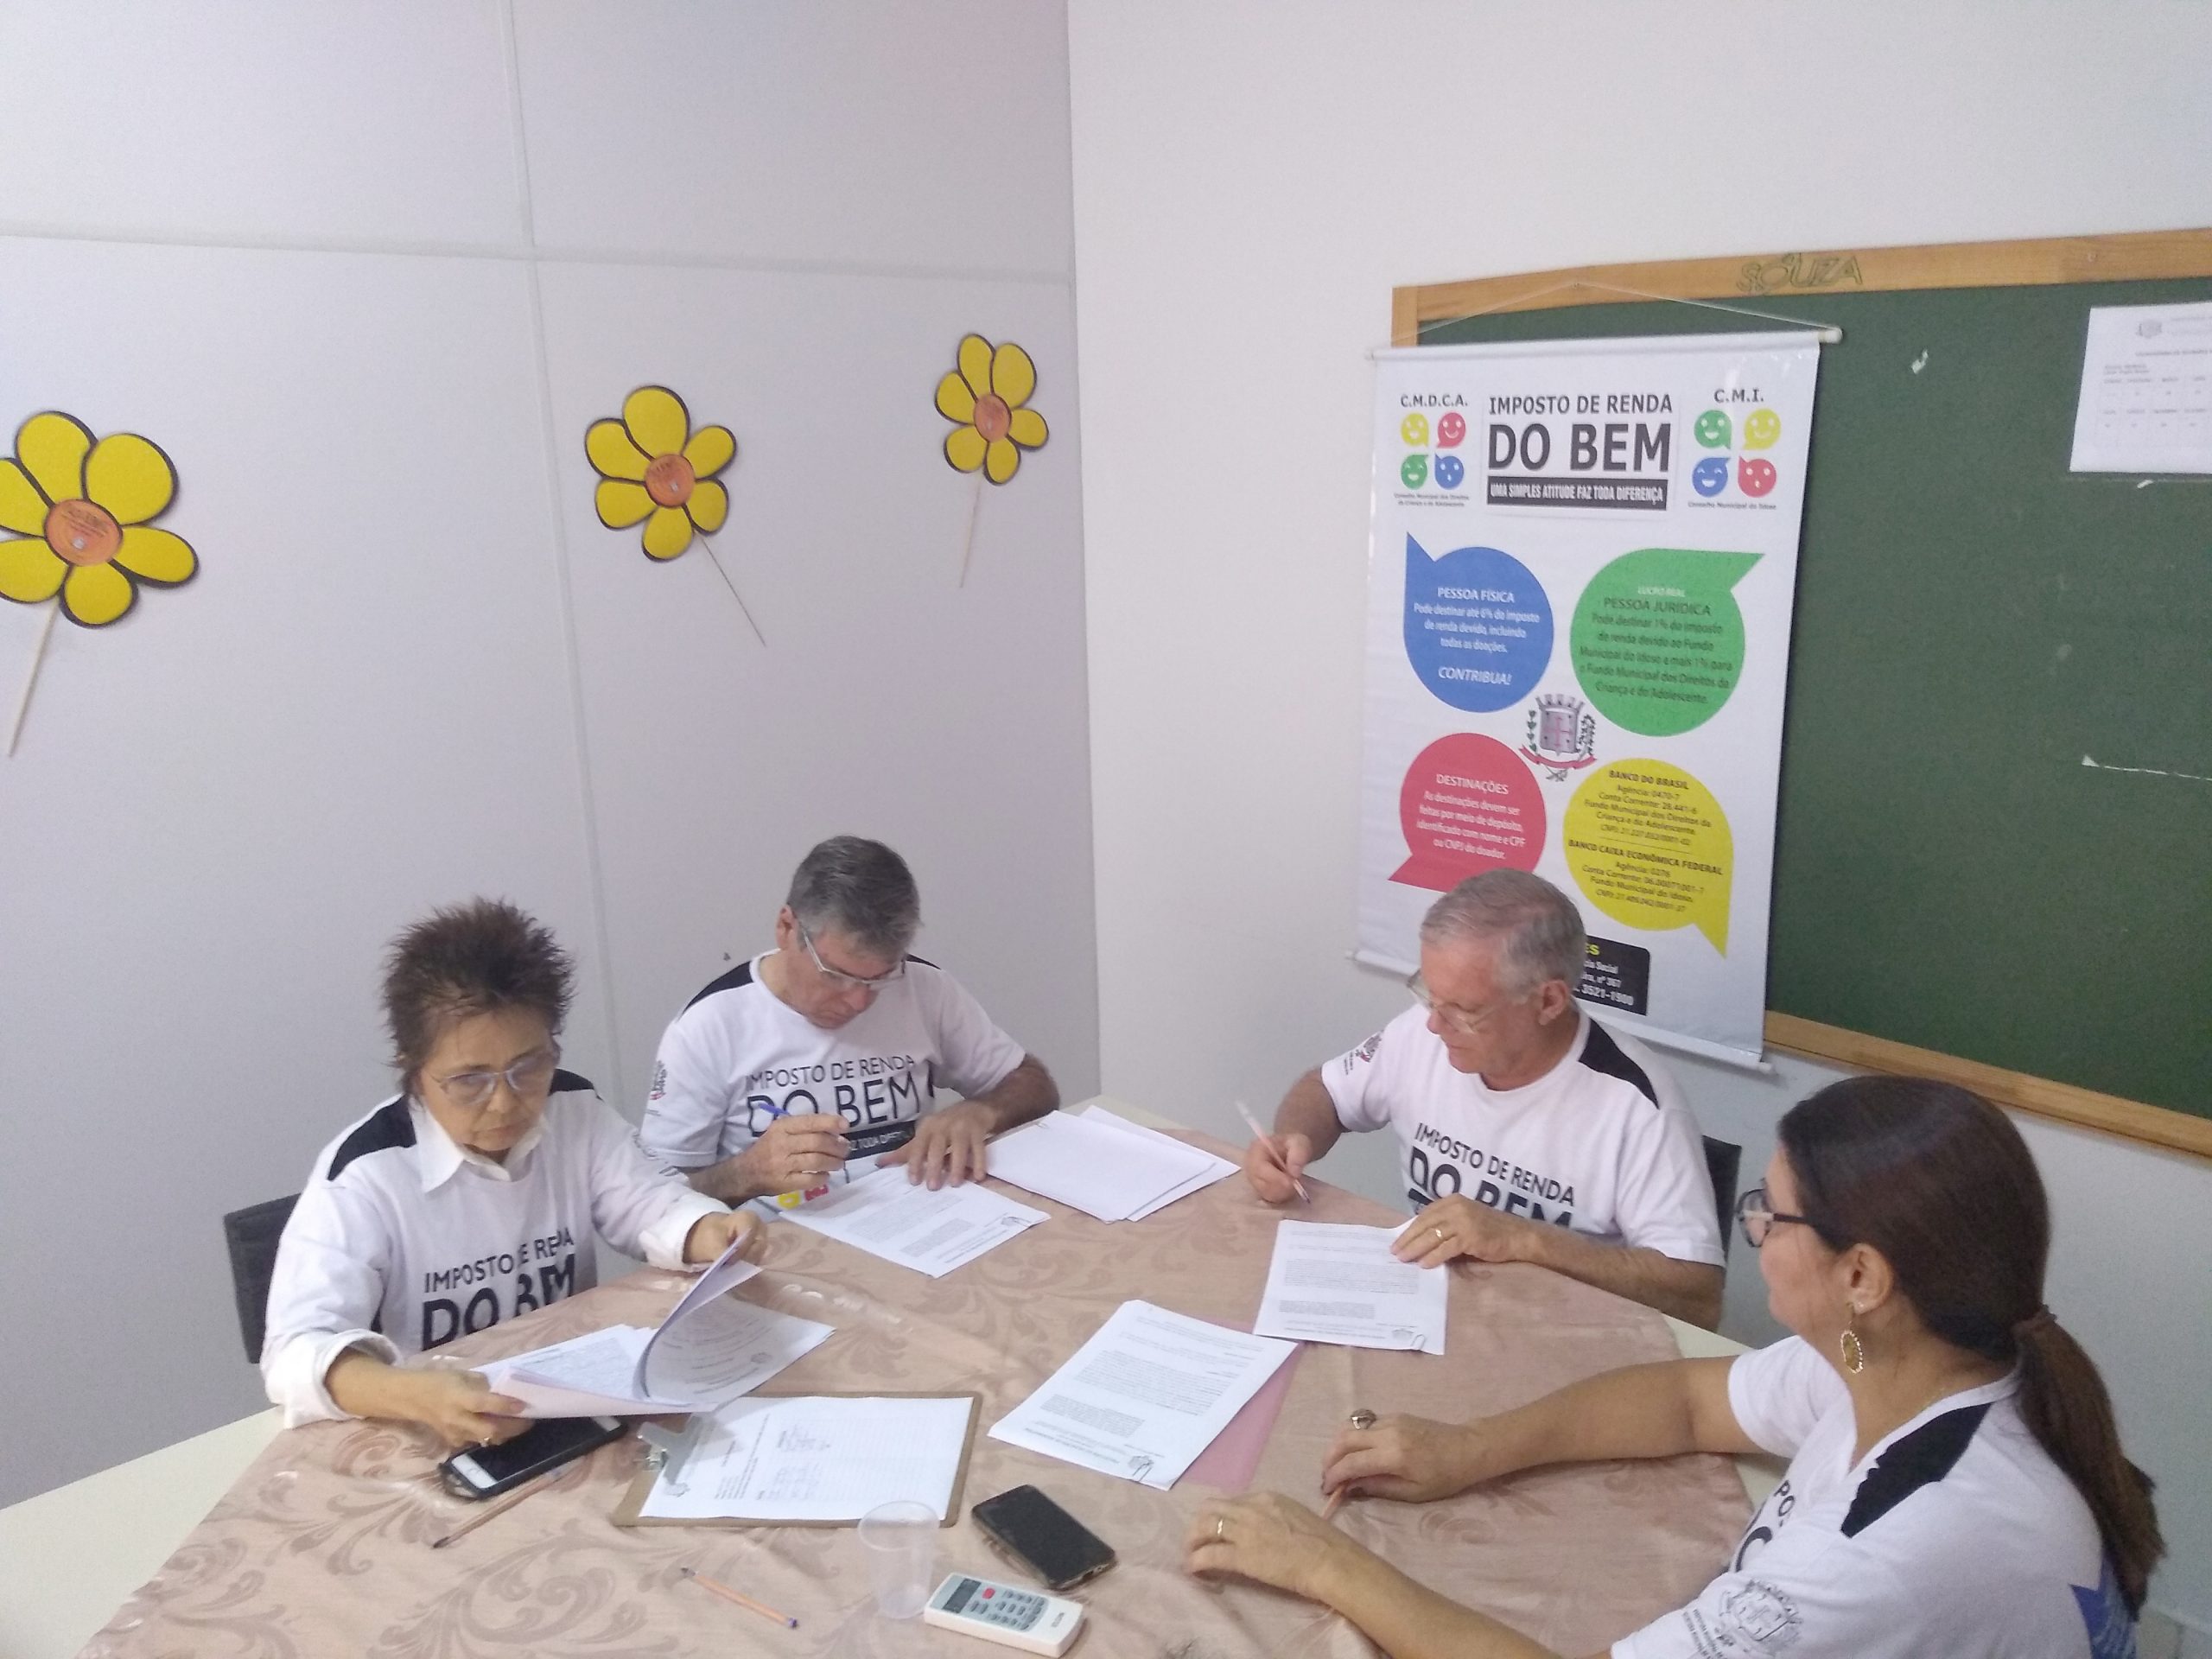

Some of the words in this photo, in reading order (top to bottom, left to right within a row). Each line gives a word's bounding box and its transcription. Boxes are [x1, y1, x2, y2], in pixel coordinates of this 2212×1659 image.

[1736, 252, 1863, 292] SOUZA
[1401, 393, 1468, 408] C.M.D.C.A.
[1489, 395, 1570, 415] IMPOSTO
[1577, 395, 1600, 414] DE
[1606, 394, 1673, 414] RENDA
[1713, 388, 1764, 403] C.M.I.
[1488, 423, 1551, 471] DO
[1570, 423, 1671, 472] BEM
[1490, 483, 1508, 499] UMA
[1509, 484, 1542, 499] SIMPLES
[1542, 485, 1576, 500] ATITUDE
[1577, 486, 1592, 500] FAZ
[1592, 485, 1615, 501] TODA
[1616, 486, 1663, 505] DIFERENÇA
[1438, 587, 1478, 601] PESSOA
[1604, 597, 1649, 611] PESSOA
[1438, 666, 1512, 685] CONTRIBUA!
[1436, 773, 1509, 794] DESTINAÇÕES
[1585, 943, 1600, 956] ES
[745, 1065, 826, 1092] IMPOSTO
[831, 1061, 855, 1081] DE
[859, 1055, 914, 1077] RENDA
[834, 1071, 920, 1128] BEM
[1410, 1146, 1461, 1199] DO
[1414, 1122, 1484, 1169] IMPOSTO
[1487, 1155, 1510, 1180] DE
[1510, 1166, 1574, 1206] RENDA
[424, 1254, 514, 1294] IMPOSTO
[534, 1227, 575, 1260] REA
[422, 1287, 499, 1352] DO
